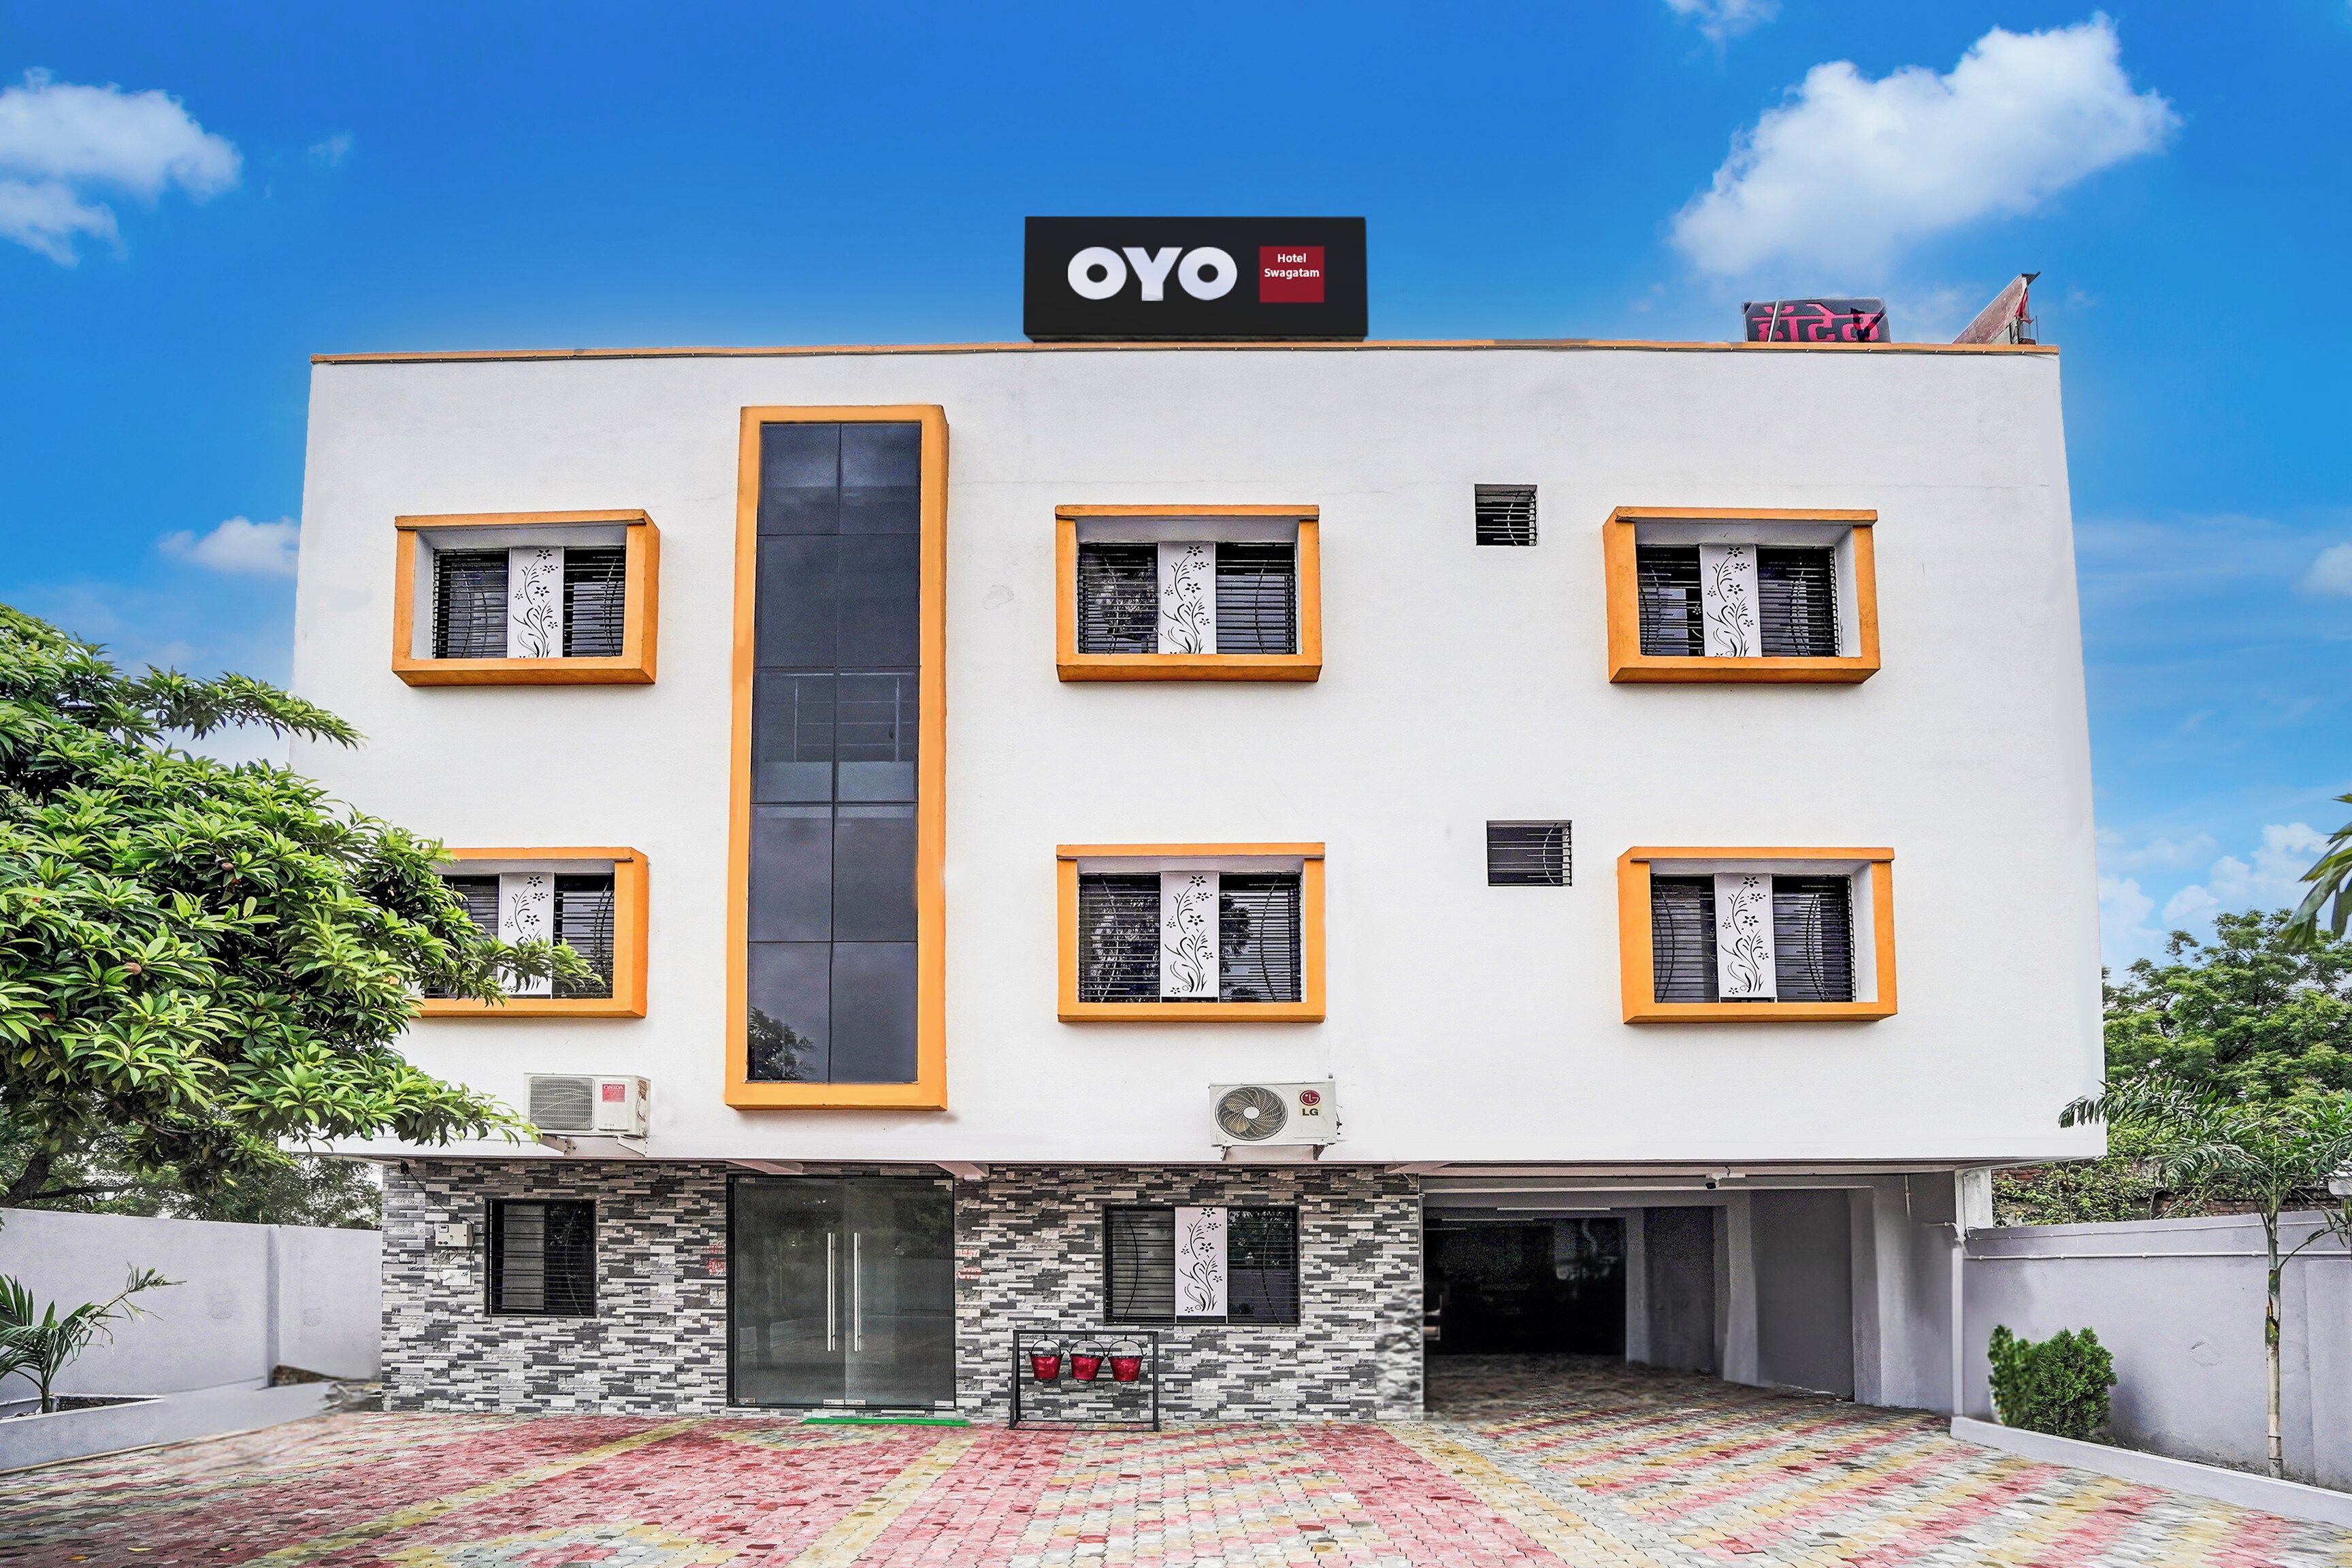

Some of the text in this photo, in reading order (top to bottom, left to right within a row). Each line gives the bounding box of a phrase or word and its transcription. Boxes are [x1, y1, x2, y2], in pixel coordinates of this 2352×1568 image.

[1277, 252, 1307, 263] Hotel
[1068, 246, 1237, 301] OYO
[1264, 267, 1320, 280] Swagatam
[1302, 1108, 1319, 1116] LG
